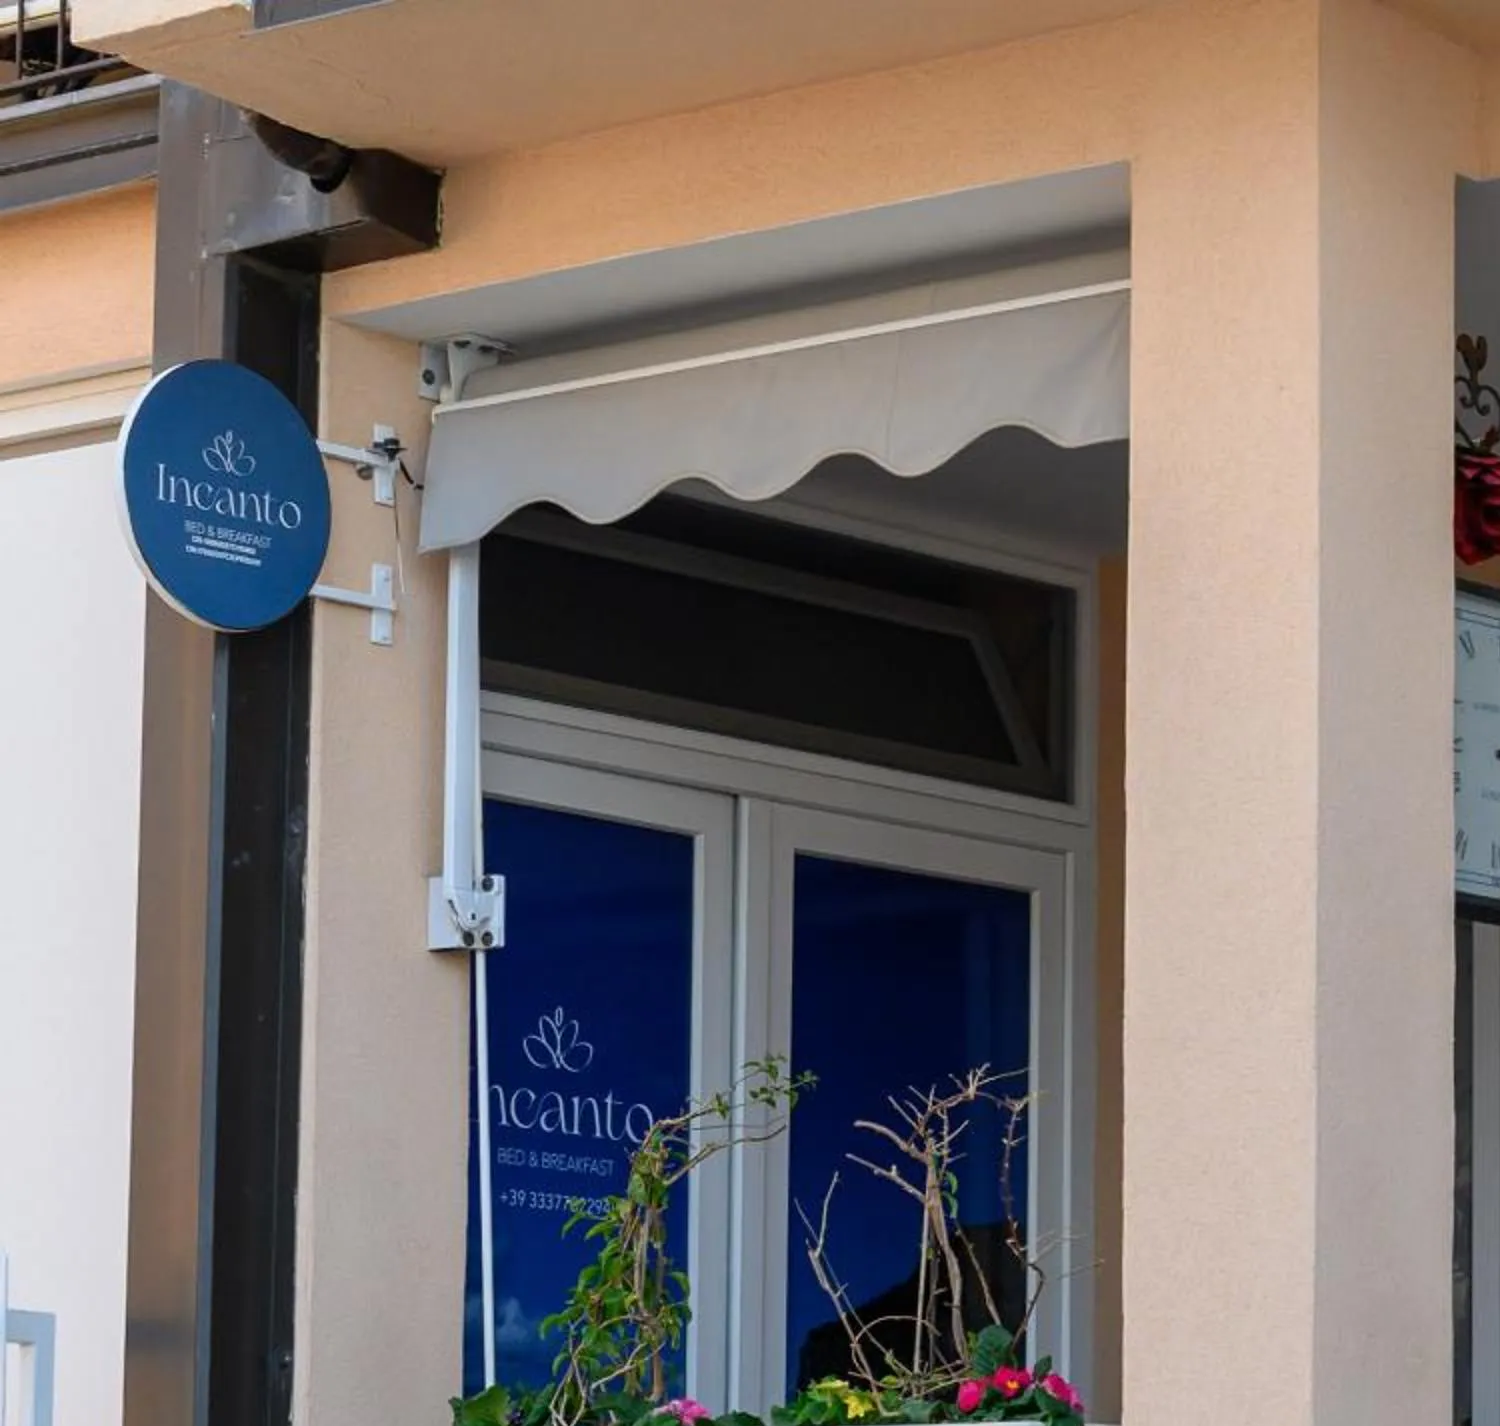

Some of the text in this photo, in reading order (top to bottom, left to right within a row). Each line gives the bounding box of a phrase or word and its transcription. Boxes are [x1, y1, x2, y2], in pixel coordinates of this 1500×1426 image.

[157, 463, 301, 529] Incanto
[183, 519, 205, 535] BED
[216, 527, 273, 549] BREAKFAST
[488, 1084, 654, 1144] ncanto
[497, 1147, 614, 1177] BED & BREAKFAST
[499, 1188, 526, 1208] +39
